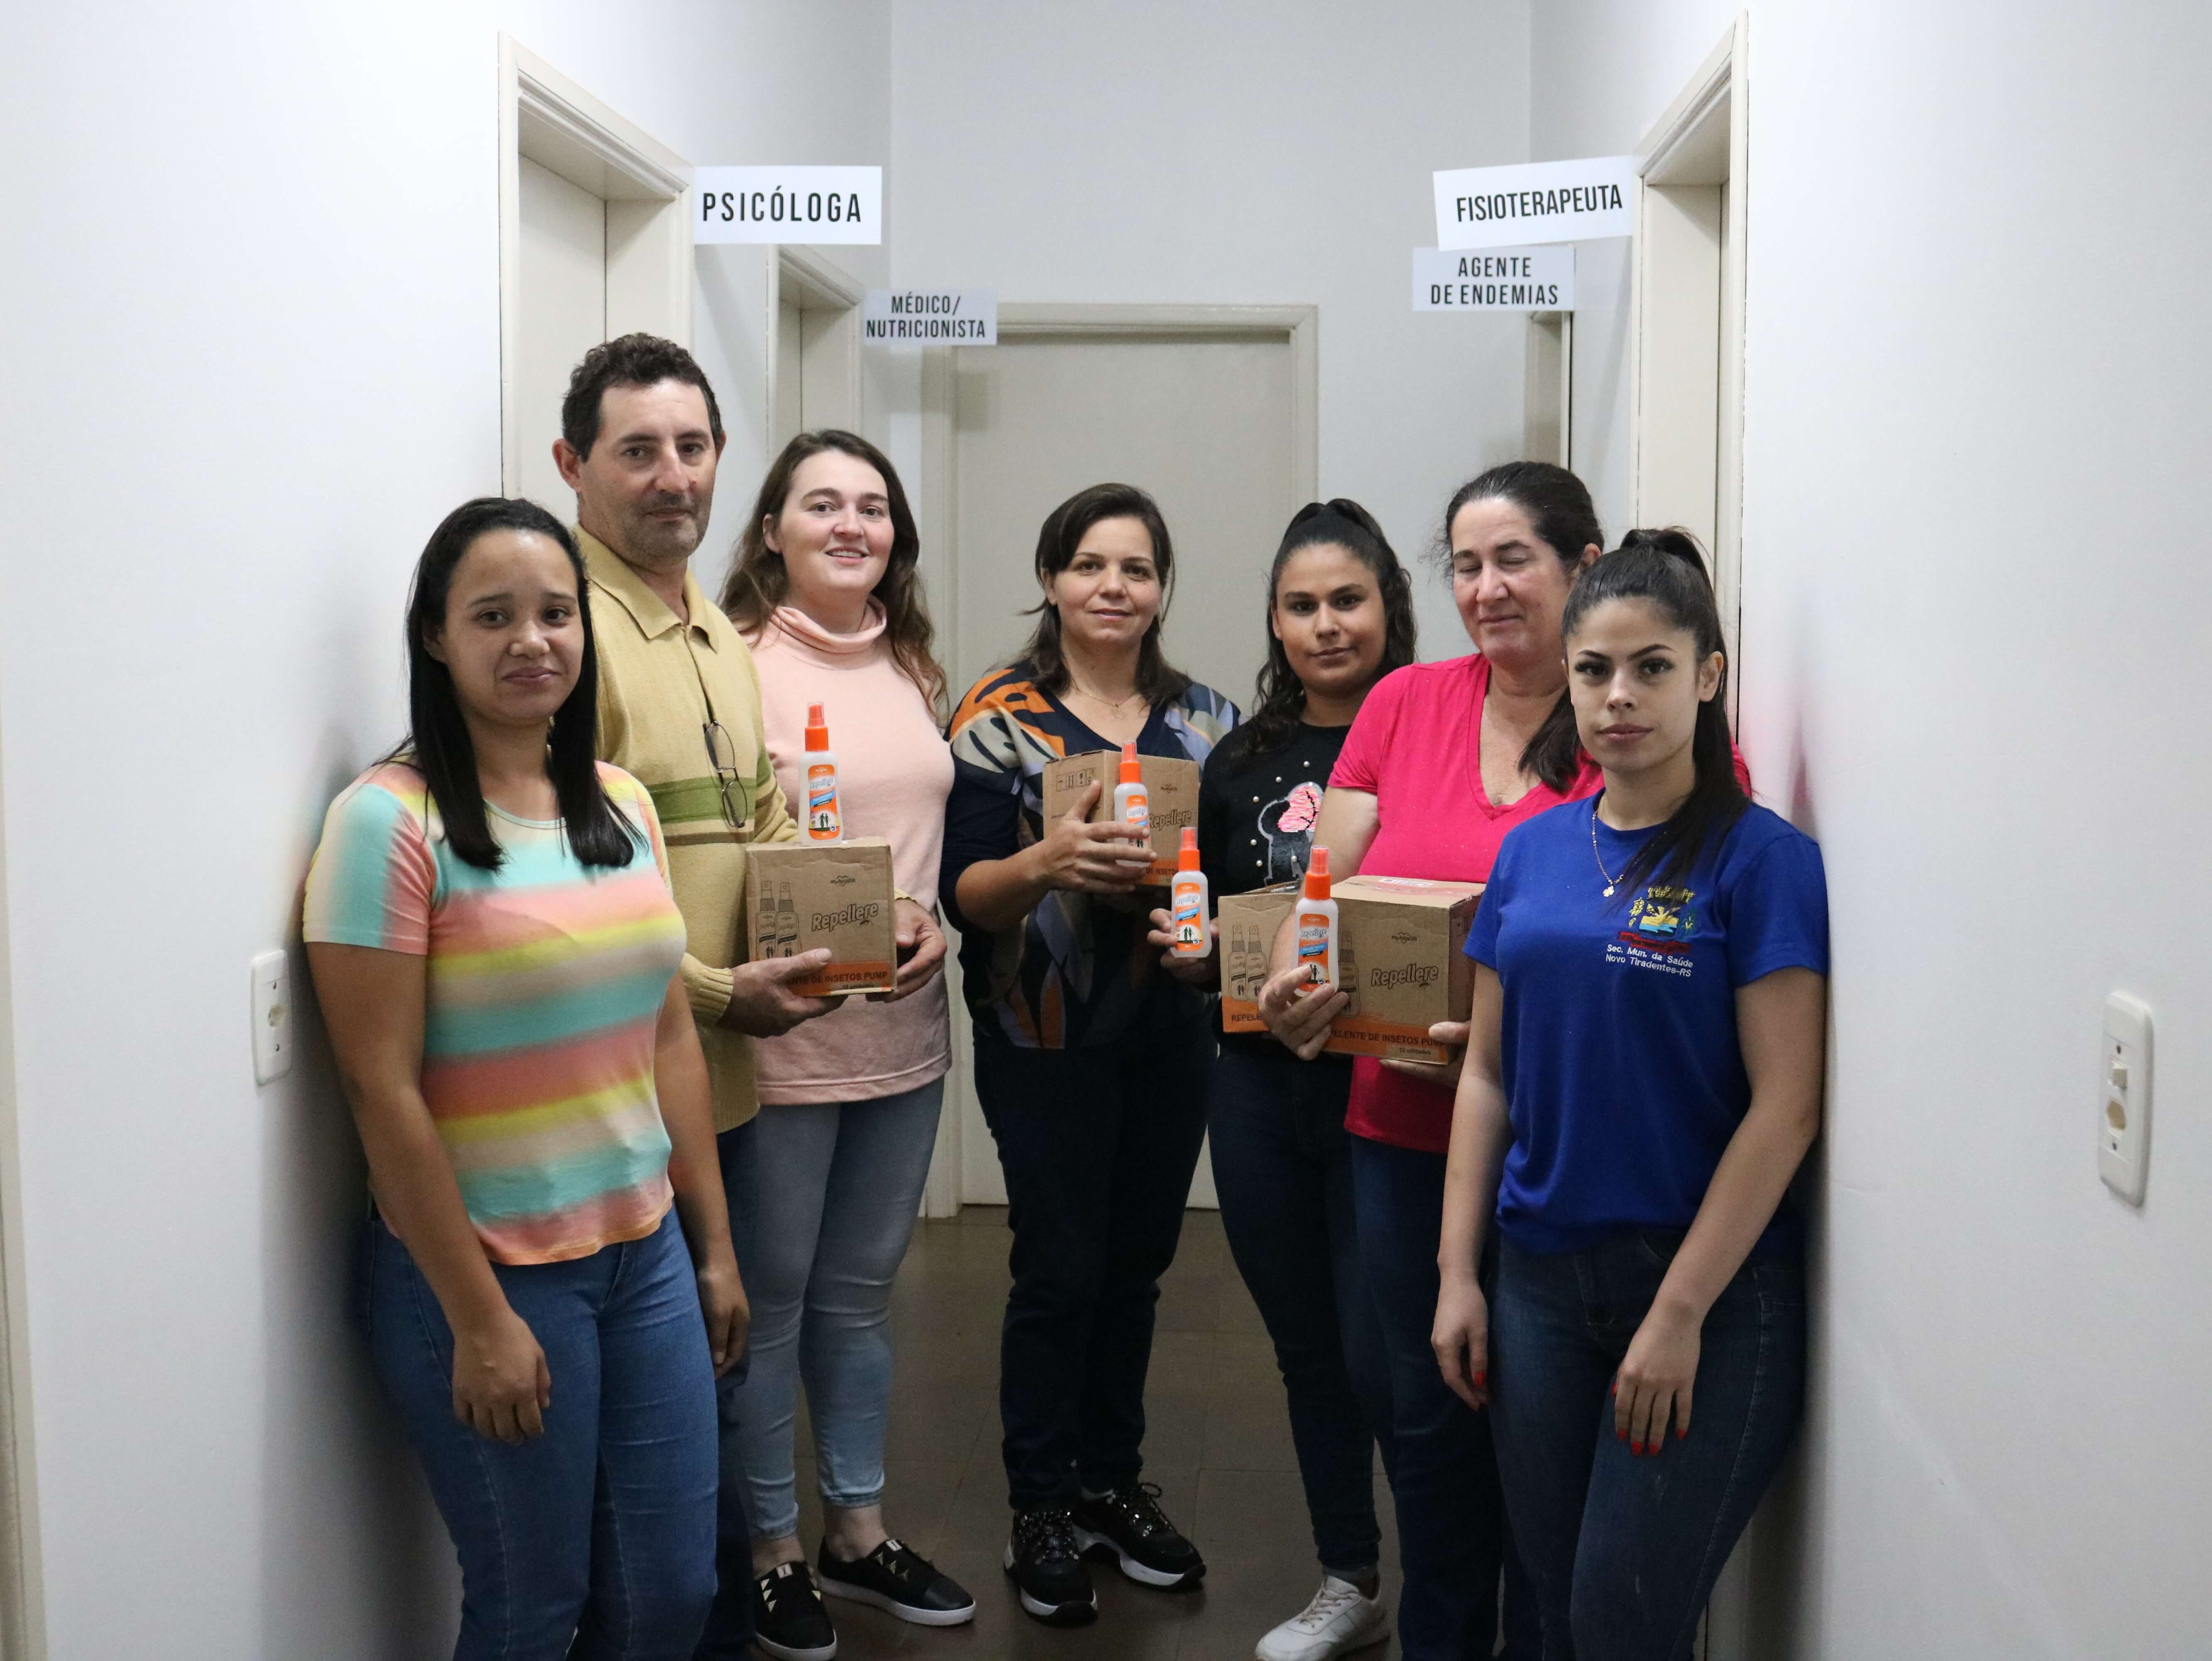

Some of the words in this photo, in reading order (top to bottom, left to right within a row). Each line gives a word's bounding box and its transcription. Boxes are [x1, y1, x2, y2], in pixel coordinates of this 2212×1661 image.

[702, 185, 861, 222] PSICÓLOGA
[1456, 184, 1622, 222] FISIOTERAPEUTA
[1458, 257, 1531, 277] AGENTE
[891, 292, 962, 316] MÉDICO/
[1431, 284, 1453, 304] DE
[1460, 284, 1558, 304] ENDEMIAS
[866, 319, 986, 338] NUTRICIONISTA
[1149, 809, 1192, 831] Repellere
[811, 903, 878, 933] Repellere
[1605, 953, 1626, 963] Novo
[1607, 944, 1623, 953] Sec.
[1627, 947, 1647, 958] Mun.
[1652, 953, 1663, 961] da
[1667, 955, 1693, 968] Saúde
[825, 973, 861, 982] INSETOS
[864, 971, 887, 980] PUMP
[1371, 963, 1439, 990] Repellere
[1330, 1029, 1365, 1040] ELENTE
[1368, 1034, 1380, 1042] DE
[1382, 1034, 1419, 1045] INSETOS
